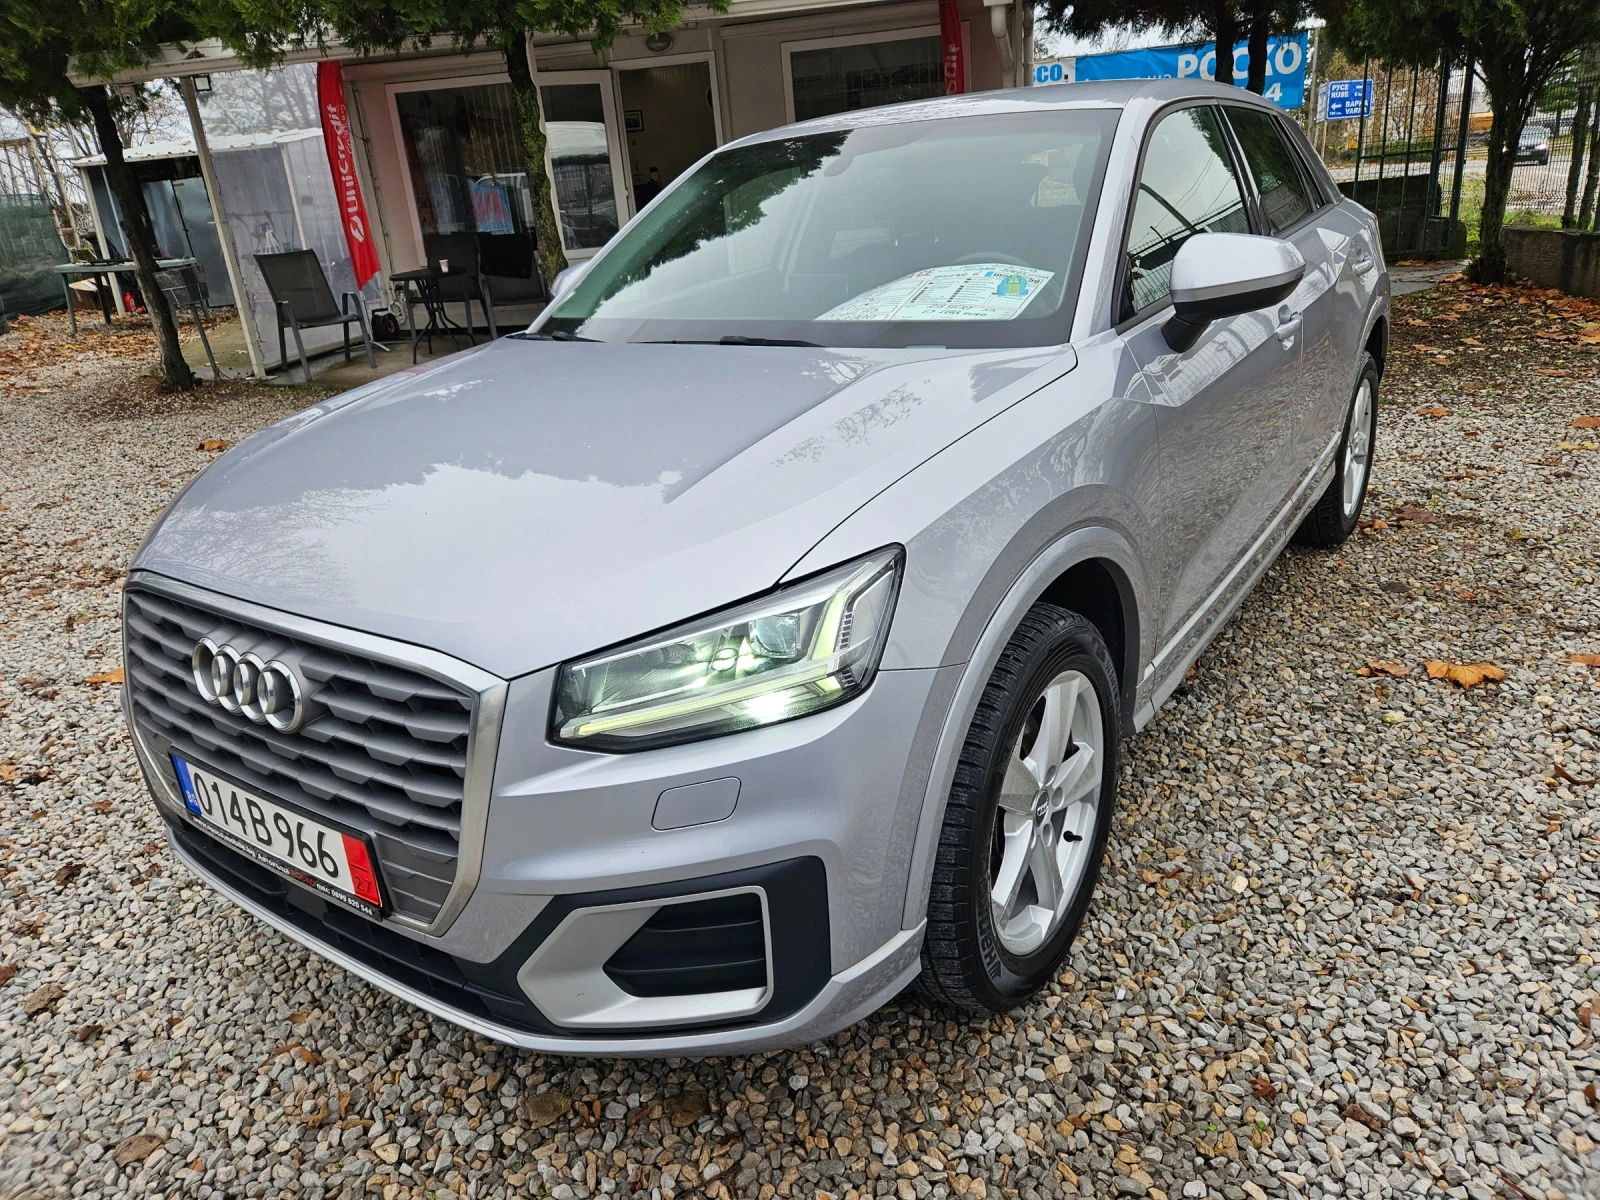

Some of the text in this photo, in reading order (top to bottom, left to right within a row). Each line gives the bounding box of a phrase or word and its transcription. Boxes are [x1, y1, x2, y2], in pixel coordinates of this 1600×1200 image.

[1331, 83, 1349, 91] РУСЕ
[1330, 91, 1349, 99] RUSE
[194, 772, 340, 879] 014B966
[354, 875, 371, 895] 27
